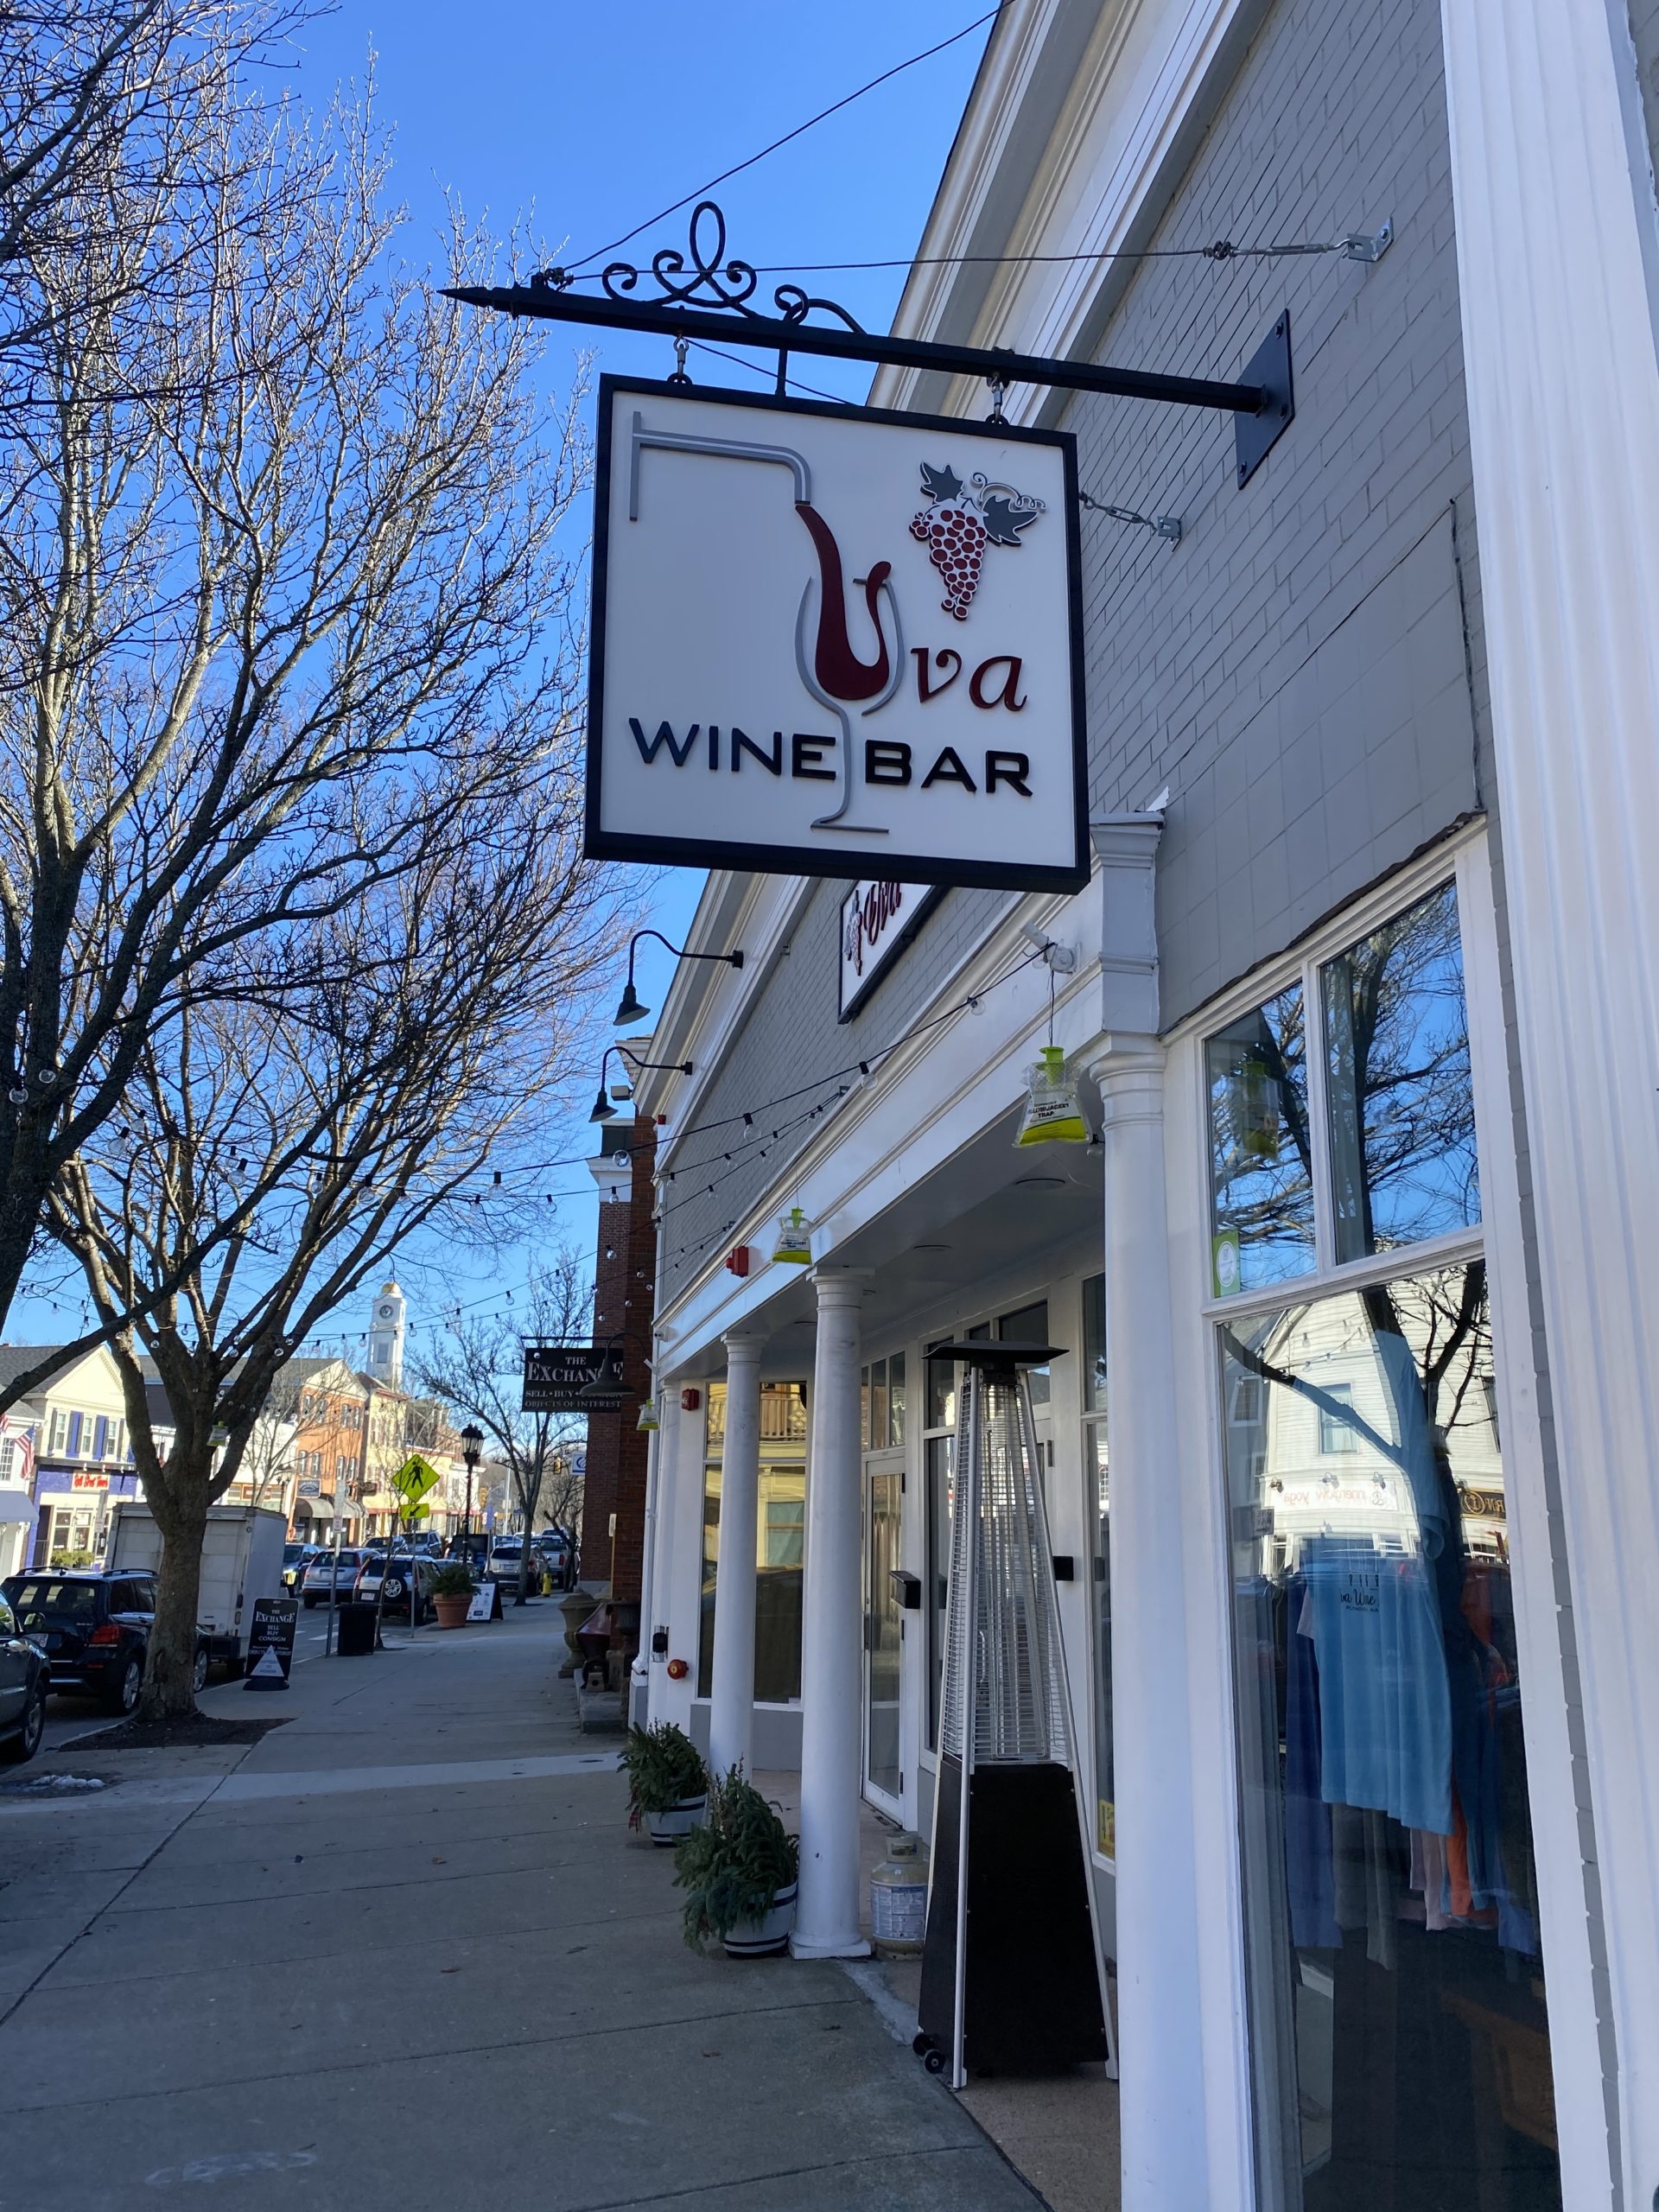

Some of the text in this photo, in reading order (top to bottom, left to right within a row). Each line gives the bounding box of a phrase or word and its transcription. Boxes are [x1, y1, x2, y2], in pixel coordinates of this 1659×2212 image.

[628, 717, 1033, 797] WINE BAR
[565, 1357, 587, 1365] THE
[527, 1361, 624, 1382] EXCHANE
[255, 1611, 296, 1624] EXCHANGE
